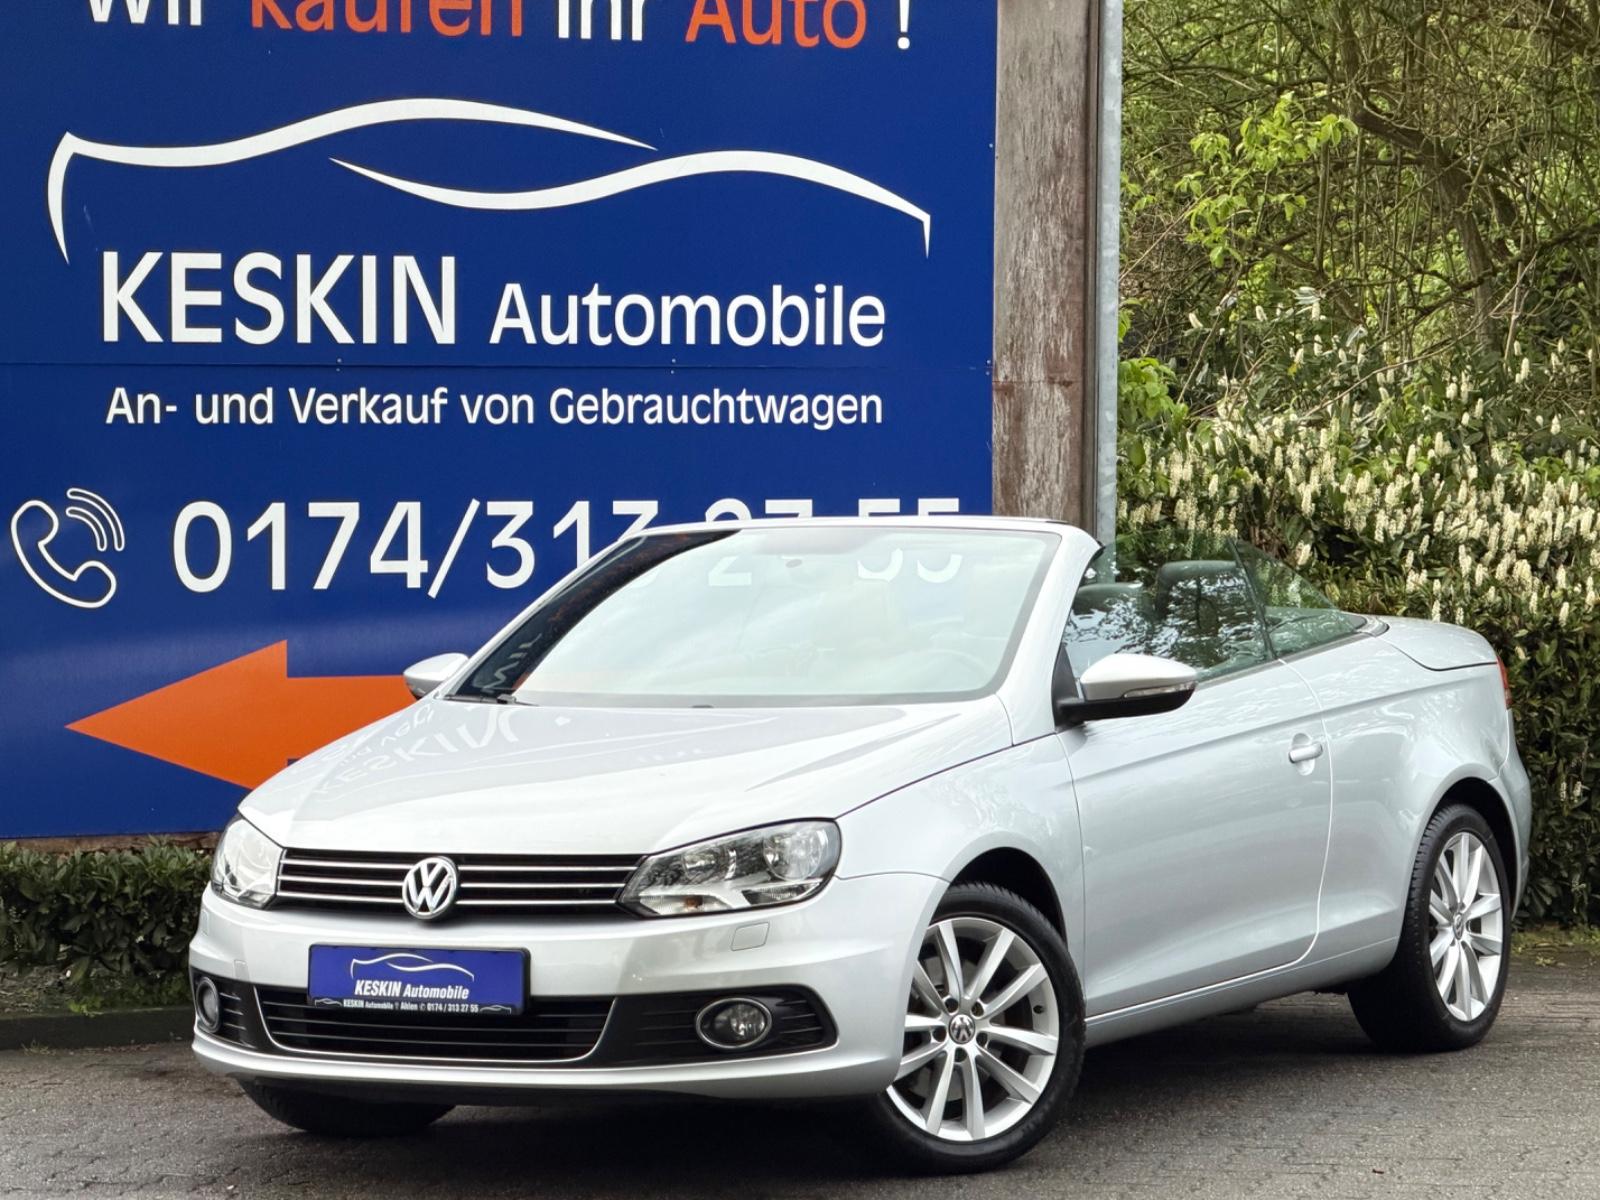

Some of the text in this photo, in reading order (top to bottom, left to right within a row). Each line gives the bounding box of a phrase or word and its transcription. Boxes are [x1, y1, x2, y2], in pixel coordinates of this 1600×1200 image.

[685, 0, 867, 49] Auto
[103, 251, 886, 347] KESKIN Automobile
[105, 386, 882, 431] An- und Verkauf von Gebrauchtwagen
[403, 857, 456, 919] VW
[343, 998, 365, 1009] KESKIN
[365, 1000, 394, 1011] Automobile
[354, 979, 470, 1000] KESKIN Automobile
